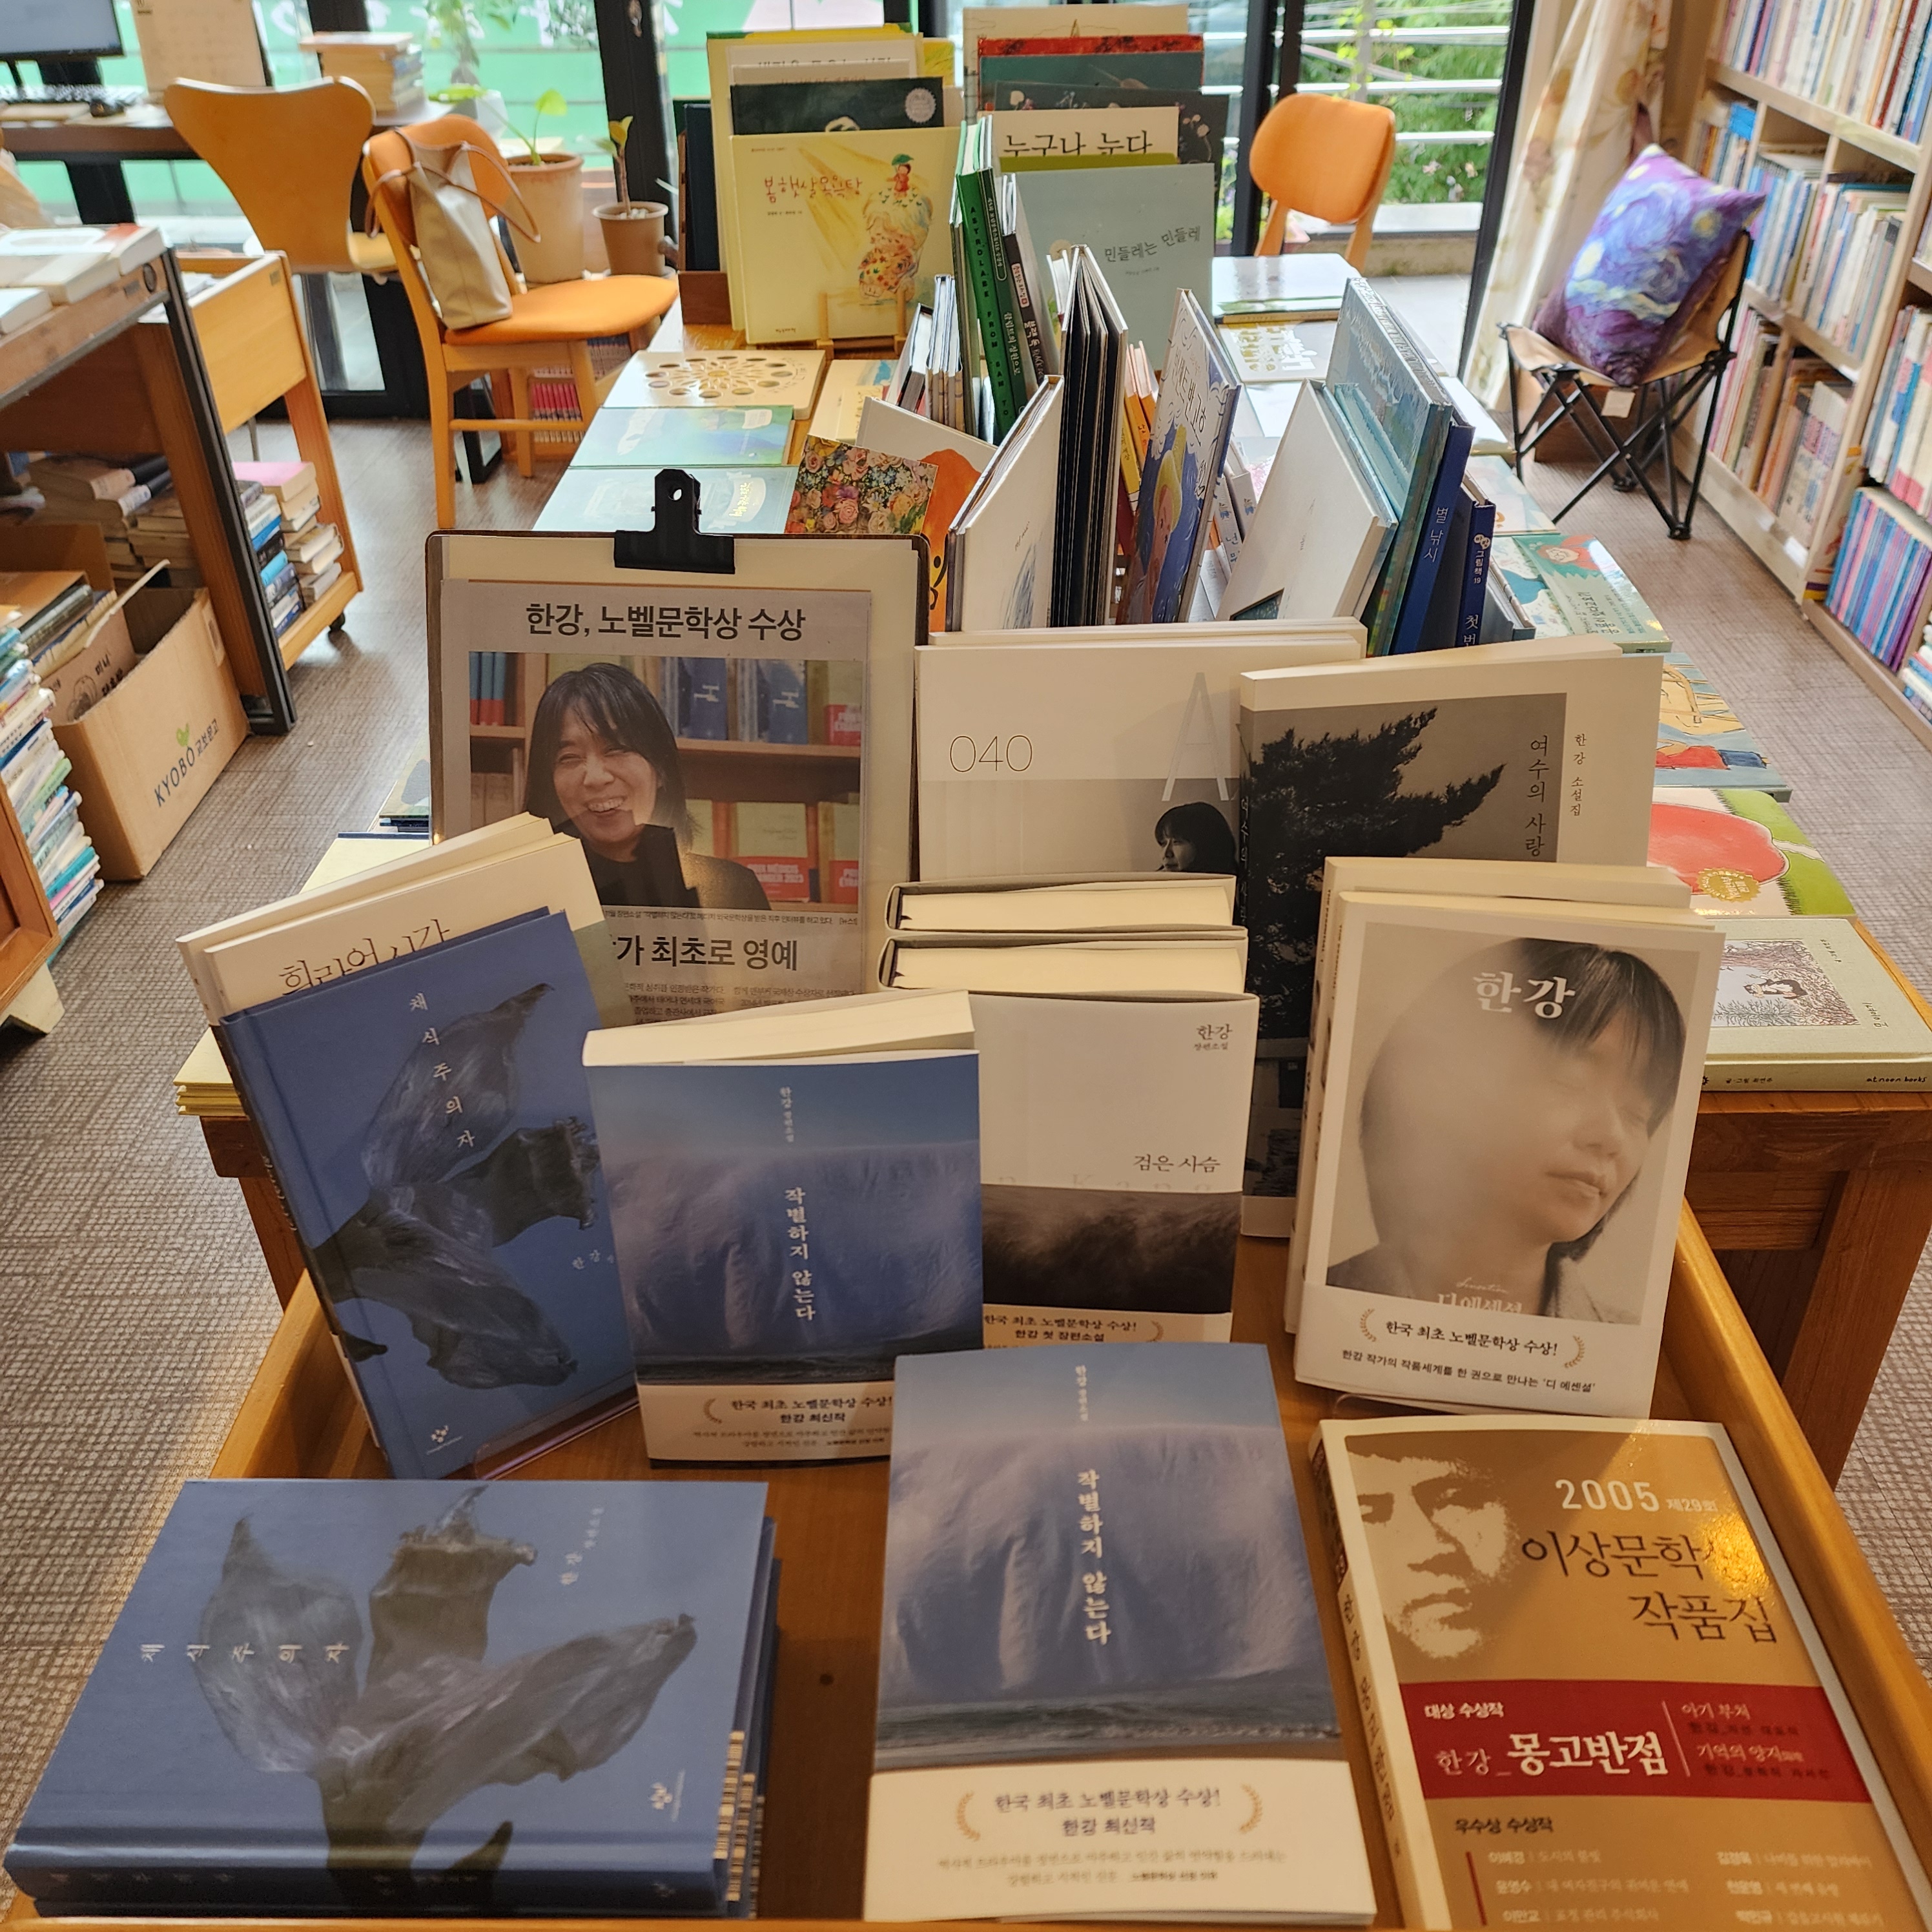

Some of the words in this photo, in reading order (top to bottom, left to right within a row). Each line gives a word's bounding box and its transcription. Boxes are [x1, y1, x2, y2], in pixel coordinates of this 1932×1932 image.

[1104, 242, 1158, 262] 민들레는
[1162, 225, 1201, 246] 민들레
[970, 206, 990, 299] ASTROLABE
[987, 311, 998, 349] FROM
[1435, 507, 1448, 524] 별
[1424, 529, 1444, 563] 낚시
[526, 603, 590, 637] 한강,
[597, 606, 743, 639] 노벨문학상
[748, 609, 807, 641] 수상
[1464, 614, 1479, 630] 첫
[195, 718, 220, 758] 교보문고
[949, 735, 1033, 773] 040
[1574, 734, 1587, 766] 한강
[153, 745, 196, 808] KYOBO
[1526, 735, 1549, 803] 여수의
[1570, 776, 1585, 817] 소설집
[1525, 813, 1547, 858] 사랑
[651, 935, 735, 967] 최초로
[743, 938, 798, 971] 영예
[1472, 971, 1576, 1020] 한강
[1196, 1023, 1233, 1042] 한강
[409, 991, 476, 1149] 채식주의자
[1904, 1074, 1928, 1085] books
[1135, 1154, 1175, 1172] 검은
[1177, 1155, 1221, 1173] 사슴
[785, 1187, 809, 1260] 작별하지
[792, 1269, 817, 1321] 않는다
[1016, 1330, 1038, 1339] 한강
[1058, 1331, 1105, 1342] 장편소설
[1041, 1318, 1104, 1330] 노벨문학상
[1107, 1321, 1137, 1332] 수상!
[1386, 1321, 1413, 1338] 한국
[1417, 1326, 1446, 1341] 최초
[1448, 1331, 1519, 1353] 노벨문학상
[1523, 1339, 1558, 1357] 수상!
[1342, 1349, 1364, 1362] 한강
[1366, 1353, 1397, 1368] 작가의
[1401, 1359, 1454, 1377] 작품세계를
[1457, 1367, 1468, 1379] 한
[1470, 1369, 1503, 1382] 권으로
[1506, 1373, 1539, 1388] 만나는
[732, 1400, 757, 1410] 한국
[792, 1397, 857, 1410] 노벨문학상
[861, 1395, 893, 1408] 수상!
[779, 1413, 805, 1424] 한강
[808, 1412, 846, 1423] 최신작
[1556, 1479, 1660, 1512] 2005
[1667, 1498, 1719, 1513] 제29회
[1076, 1470, 1104, 1559] 작별하지
[1082, 1570, 1112, 1645] 않는다
[1627, 1591, 1778, 1643] 작품집
[1424, 1703, 1455, 1720] 대상
[1459, 1701, 1505, 1720] 수상작
[1507, 1731, 1669, 1776] 몽고반점
[995, 1791, 1030, 1813] 한국
[1036, 1791, 1073, 1811] 최초
[1079, 1788, 1172, 1809] 노벨문학상
[1175, 1787, 1221, 1808] 수상!
[1062, 1818, 1097, 1837] 한강
[1102, 1816, 1156, 1836] 최신작
[1455, 1818, 1502, 1834] 우수상
[1507, 1816, 1555, 1834] 수상작
